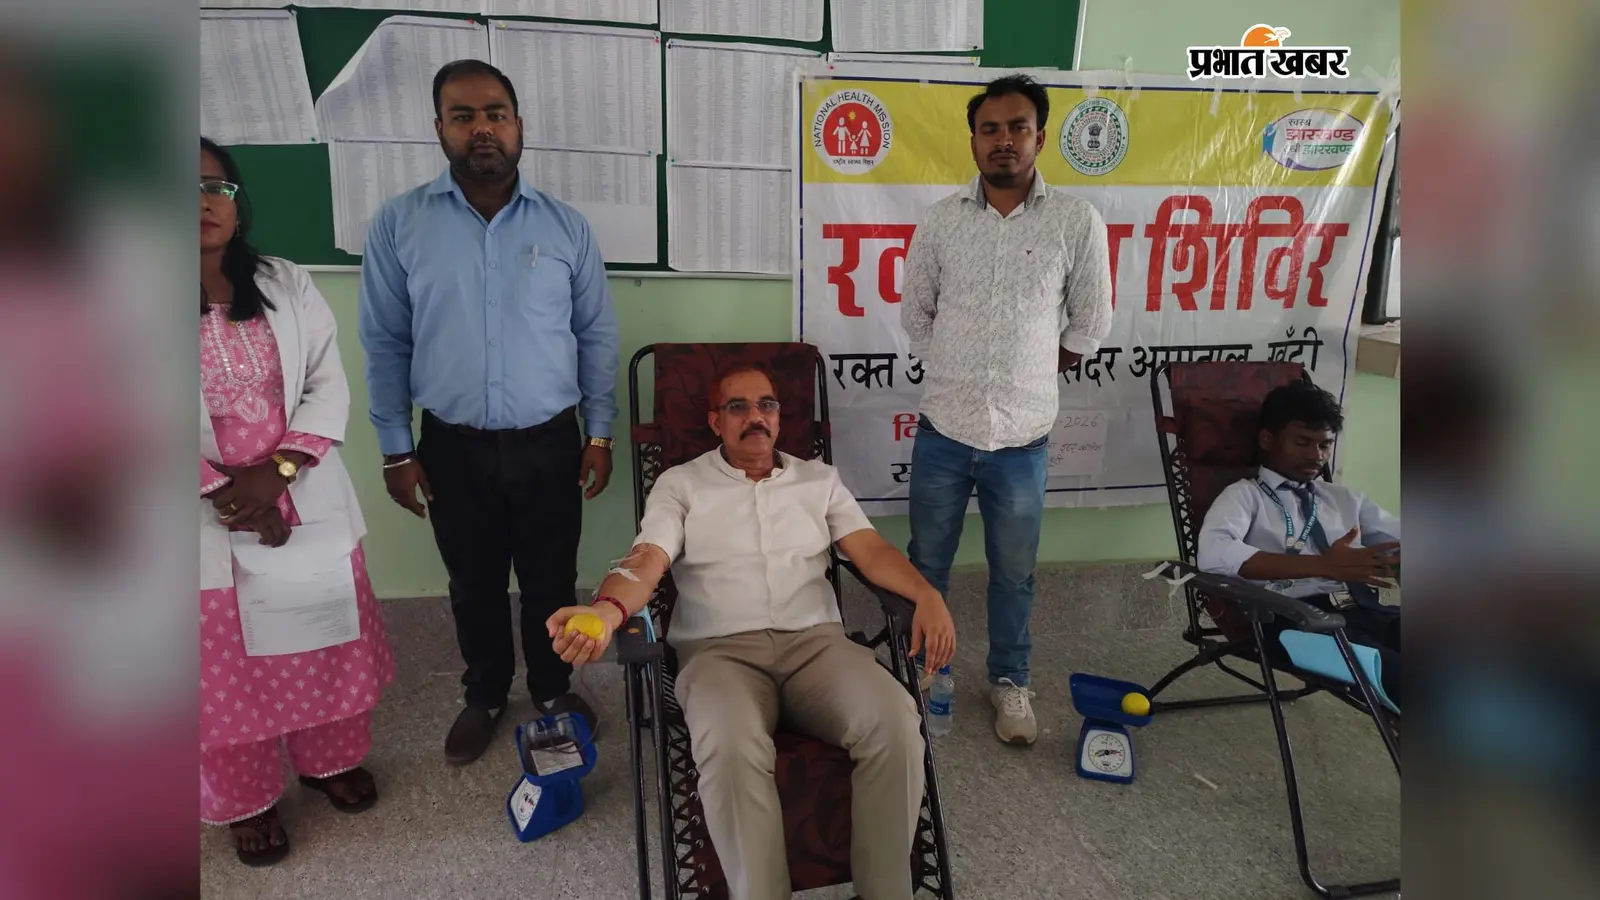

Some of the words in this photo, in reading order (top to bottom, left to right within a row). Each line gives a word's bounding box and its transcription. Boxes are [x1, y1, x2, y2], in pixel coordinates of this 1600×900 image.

[813, 99, 837, 147] NATIONAL
[837, 91, 875, 107] HEALTH
[873, 103, 891, 149] MISSION
[1144, 195, 1350, 312] शिविर
[829, 352, 898, 390] रक्त
